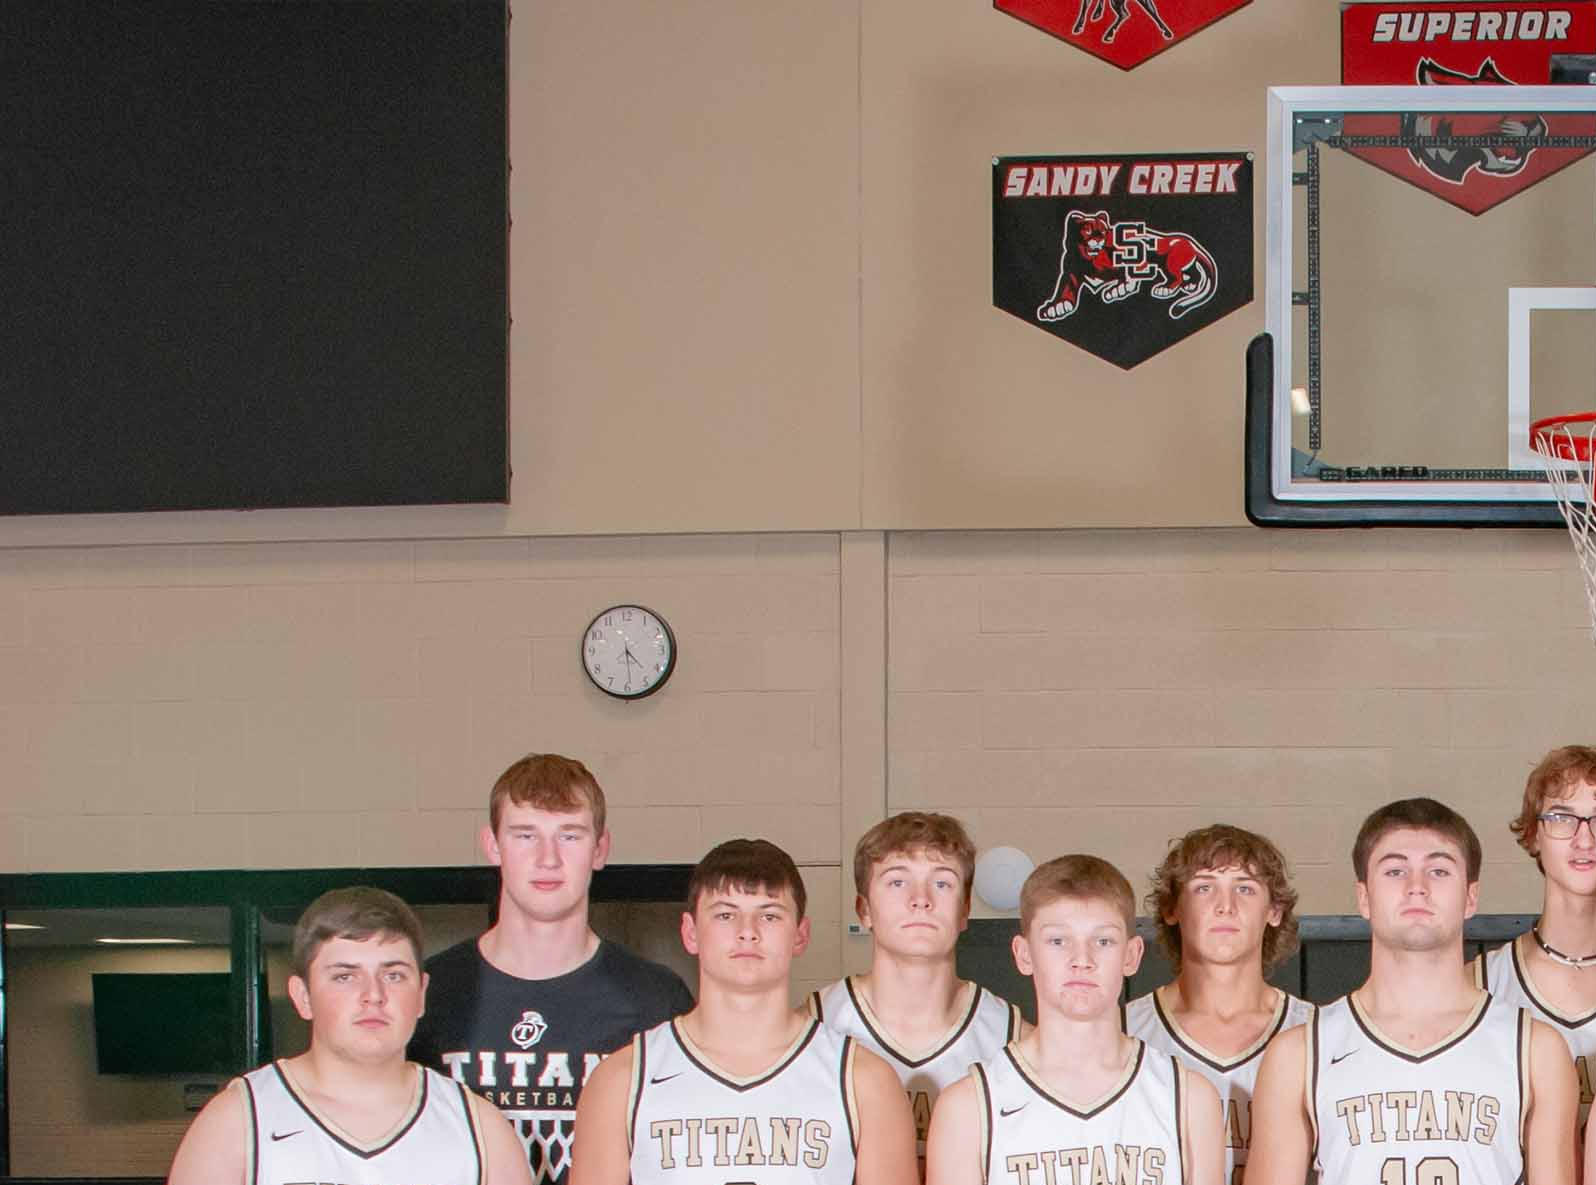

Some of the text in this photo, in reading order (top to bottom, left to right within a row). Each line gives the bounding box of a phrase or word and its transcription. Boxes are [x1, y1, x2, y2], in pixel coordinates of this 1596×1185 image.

[1372, 11, 1572, 43] SUPERIOR
[1003, 161, 1243, 197] SANDY CREEK
[1336, 1091, 1500, 1146] TITANS
[650, 1117, 832, 1169] TITANS
